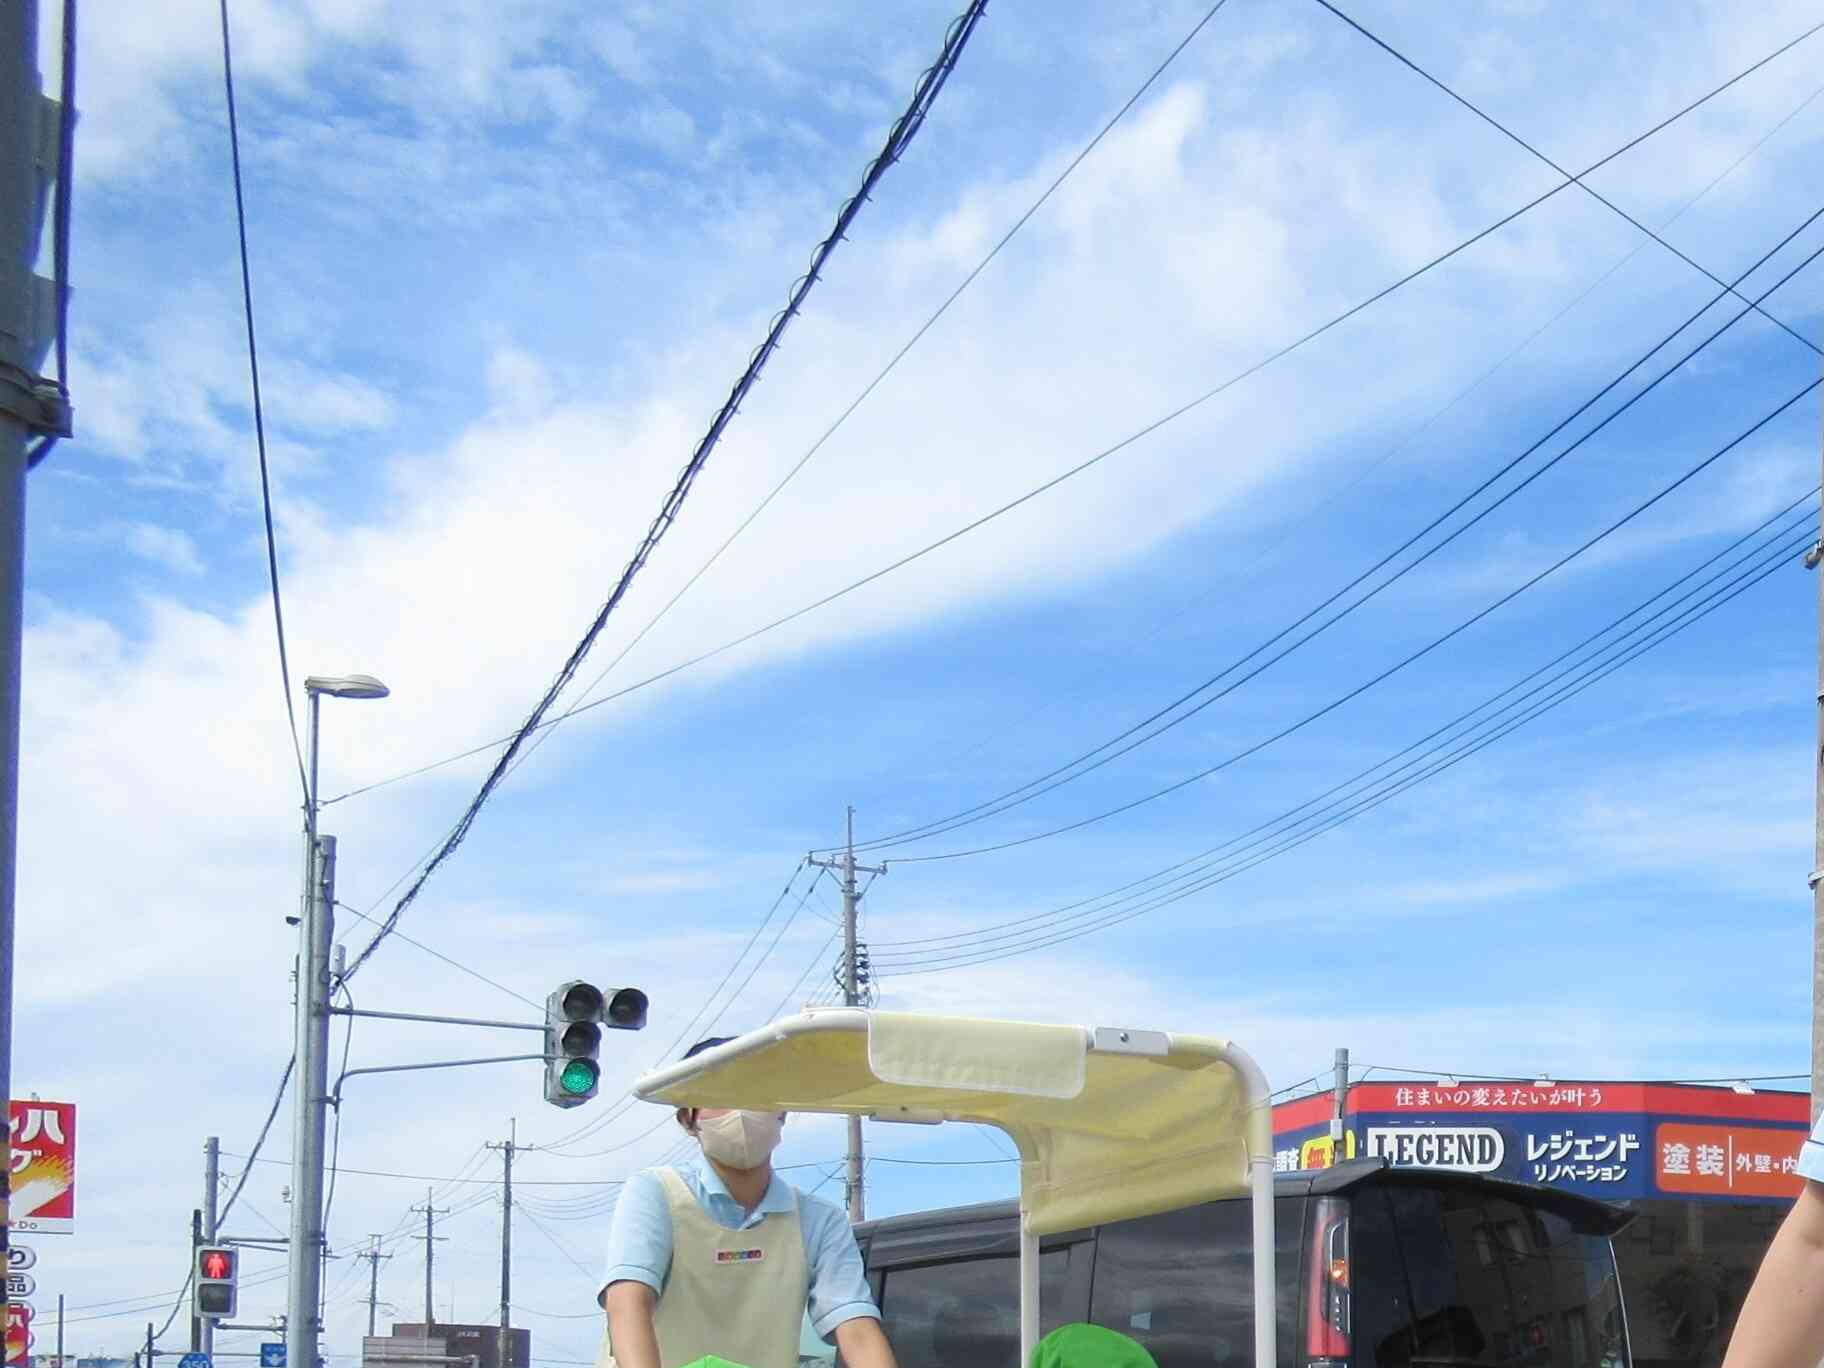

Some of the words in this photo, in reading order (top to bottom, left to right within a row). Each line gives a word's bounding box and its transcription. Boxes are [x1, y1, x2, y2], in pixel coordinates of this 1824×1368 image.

[1395, 1088, 1602, 1107] 住まいの変えたいが叶う
[1375, 1133, 1496, 1166] LEGEND
[1527, 1129, 1640, 1162] レジェンド
[1662, 1143, 1726, 1177] 塗装
[1535, 1163, 1628, 1182] リノベーション
